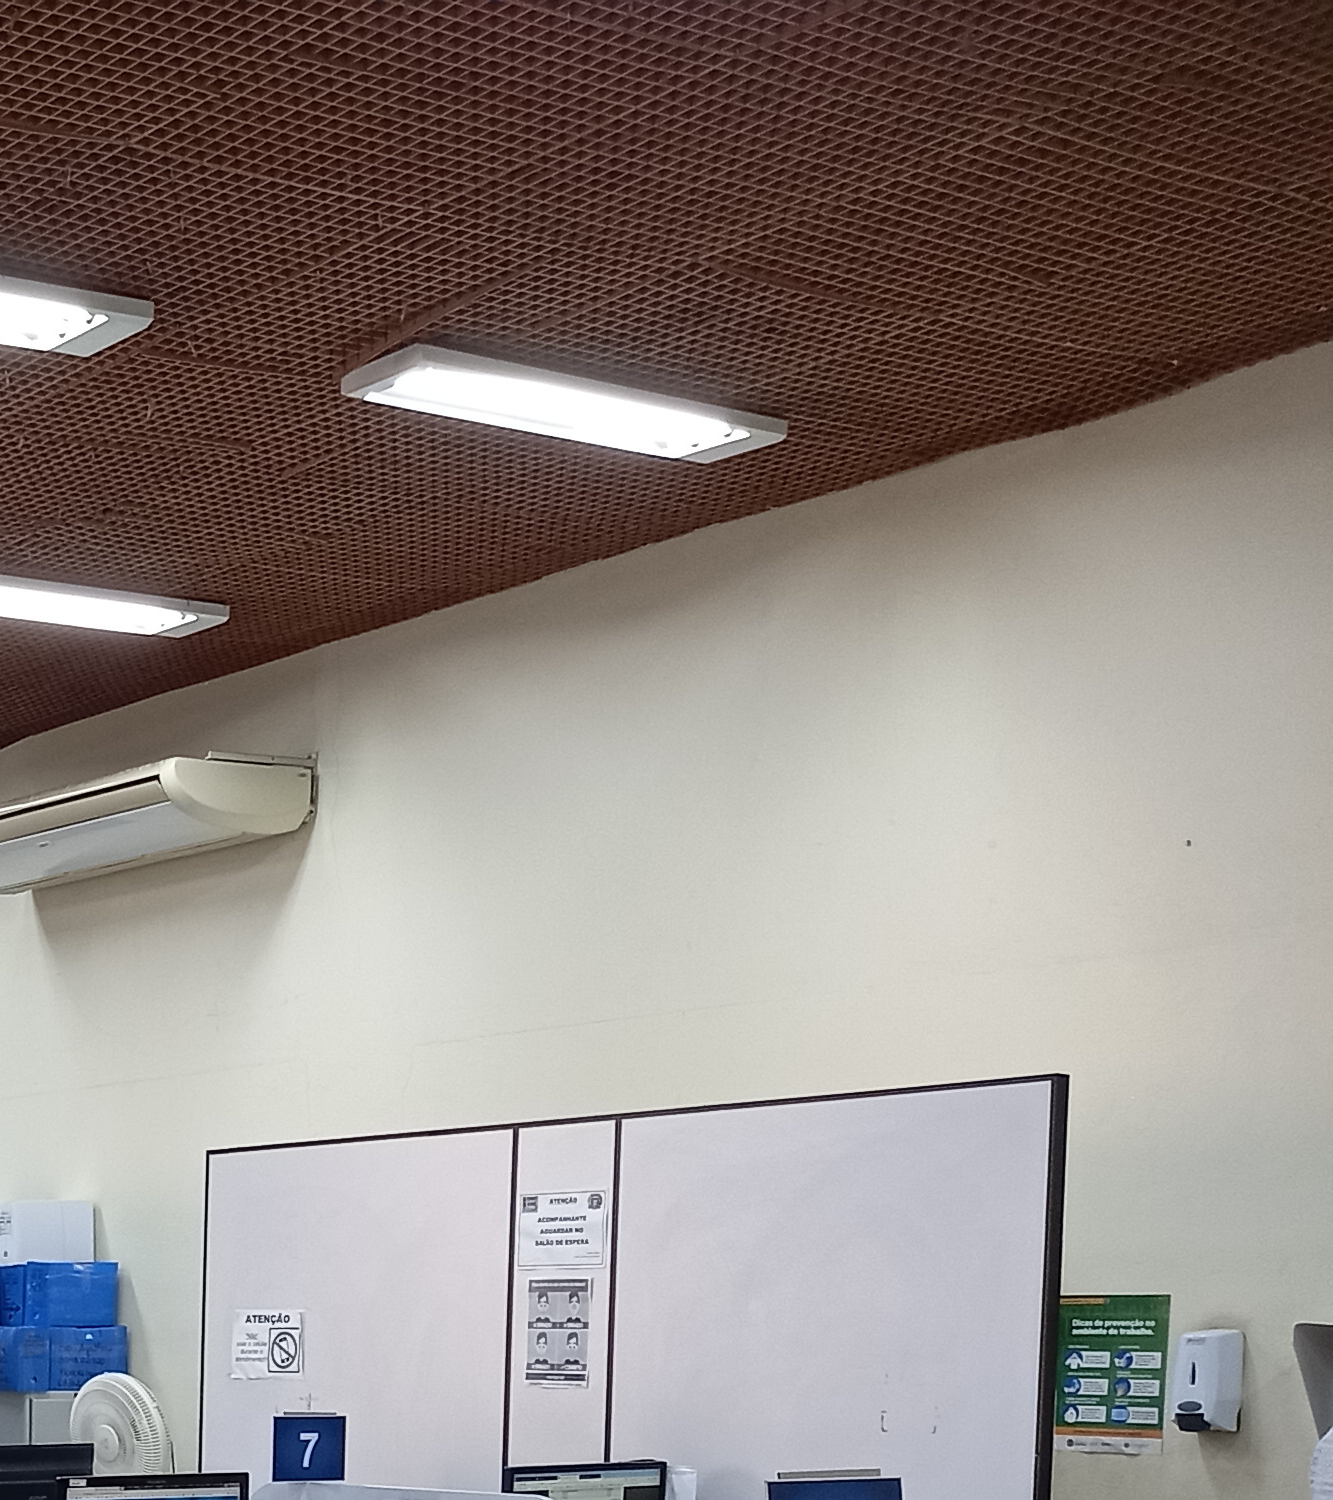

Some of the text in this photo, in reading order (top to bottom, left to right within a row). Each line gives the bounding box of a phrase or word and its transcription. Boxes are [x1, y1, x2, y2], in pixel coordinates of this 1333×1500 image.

[244, 1312, 291, 1326] ATENÇÃO
[1071, 1318, 1094, 1327] Dicas
[299, 1432, 320, 1468] 7
